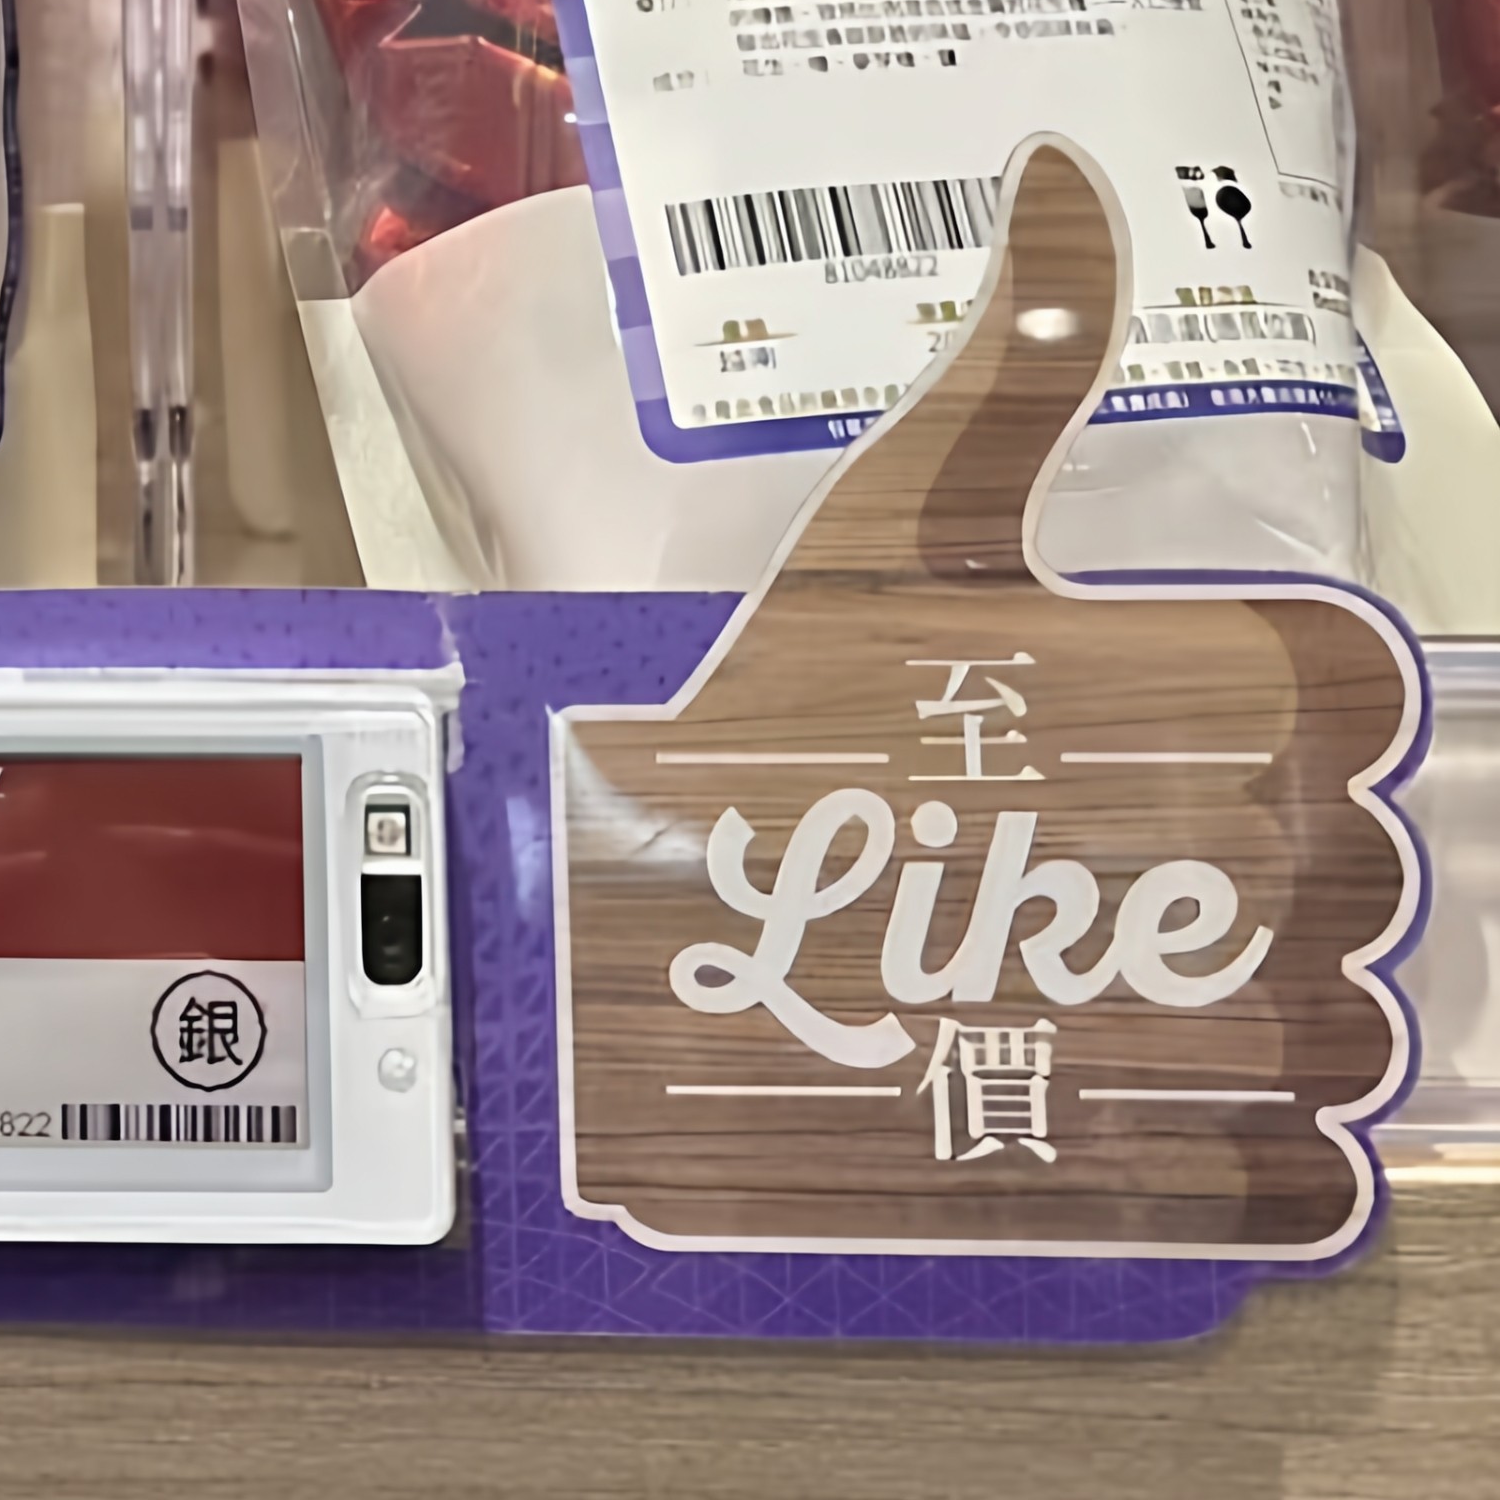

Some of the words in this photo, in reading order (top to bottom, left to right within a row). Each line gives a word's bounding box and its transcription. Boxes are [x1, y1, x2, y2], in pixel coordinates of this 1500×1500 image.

[906, 651, 1046, 782] 至
[669, 788, 1274, 1069] Like
[178, 996, 243, 1066] 銀
[915, 1017, 1058, 1163] 價
